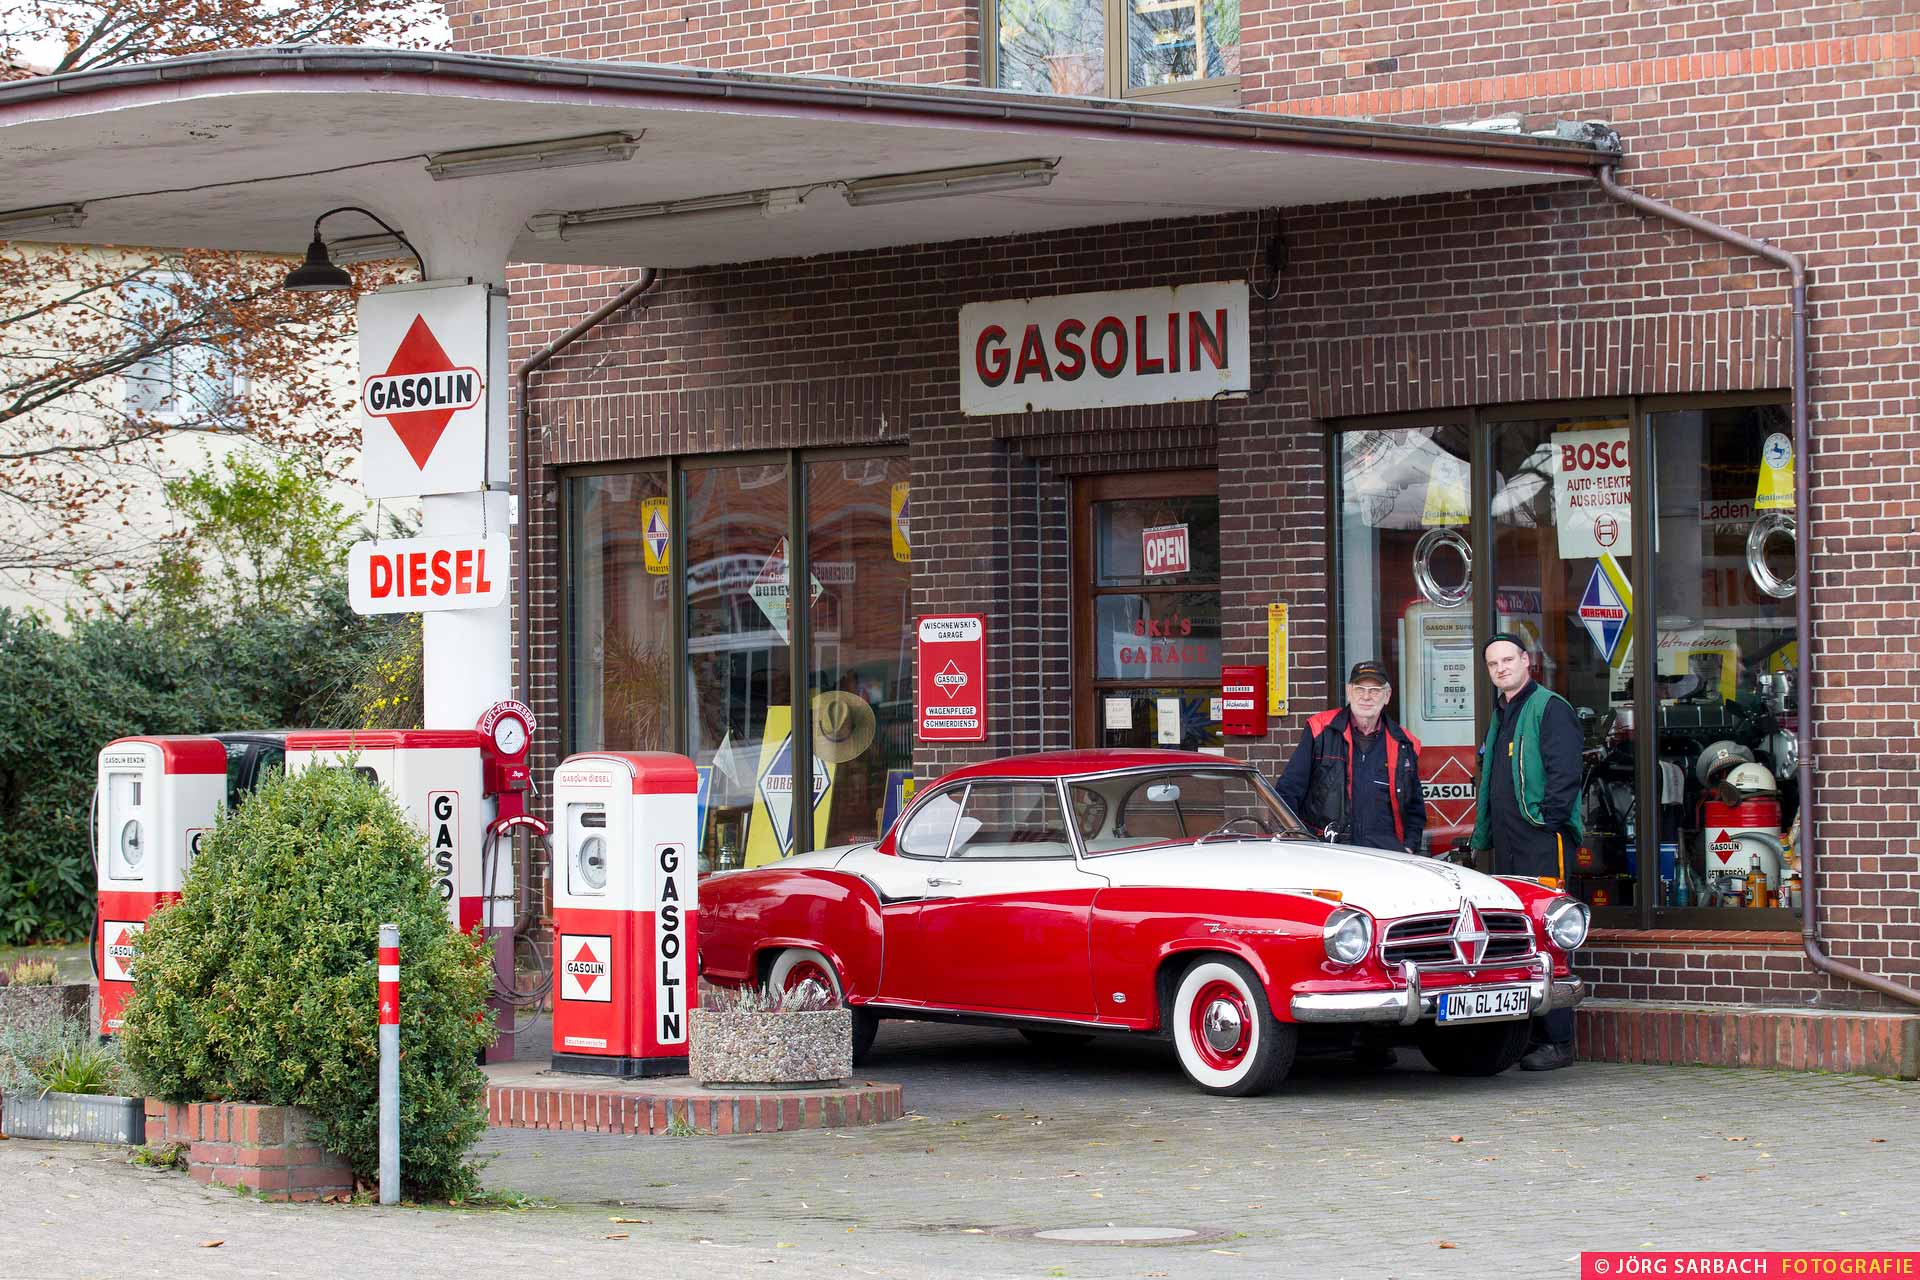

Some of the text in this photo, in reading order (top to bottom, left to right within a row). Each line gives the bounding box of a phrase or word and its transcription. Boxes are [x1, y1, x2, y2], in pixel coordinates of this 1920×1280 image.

[976, 308, 1228, 388] GASOLIN
[370, 373, 472, 411] GASOLIN
[1146, 536, 1185, 568] OPEN
[369, 548, 491, 599] DIESEL
[924, 620, 977, 630] WISCHNEWSKI'S
[938, 631, 963, 639] GARAGE
[1119, 645, 1208, 664] GARAGE
[937, 675, 964, 684] GASOLIN
[929, 707, 974, 715] WAGENPFLEGE
[925, 719, 976, 728] SCHMIERDIENST
[562, 774, 610, 783] GASOLIN DIESEL
[766, 776, 822, 791] BORGD
[1710, 842, 1740, 851] GASOLIN
[660, 847, 680, 1040] GASOLIN
[567, 962, 604, 974] GASOLIN
[1448, 995, 1466, 1016] UN
[1475, 993, 1492, 1014] GL
[1495, 989, 1528, 1013] 143H
